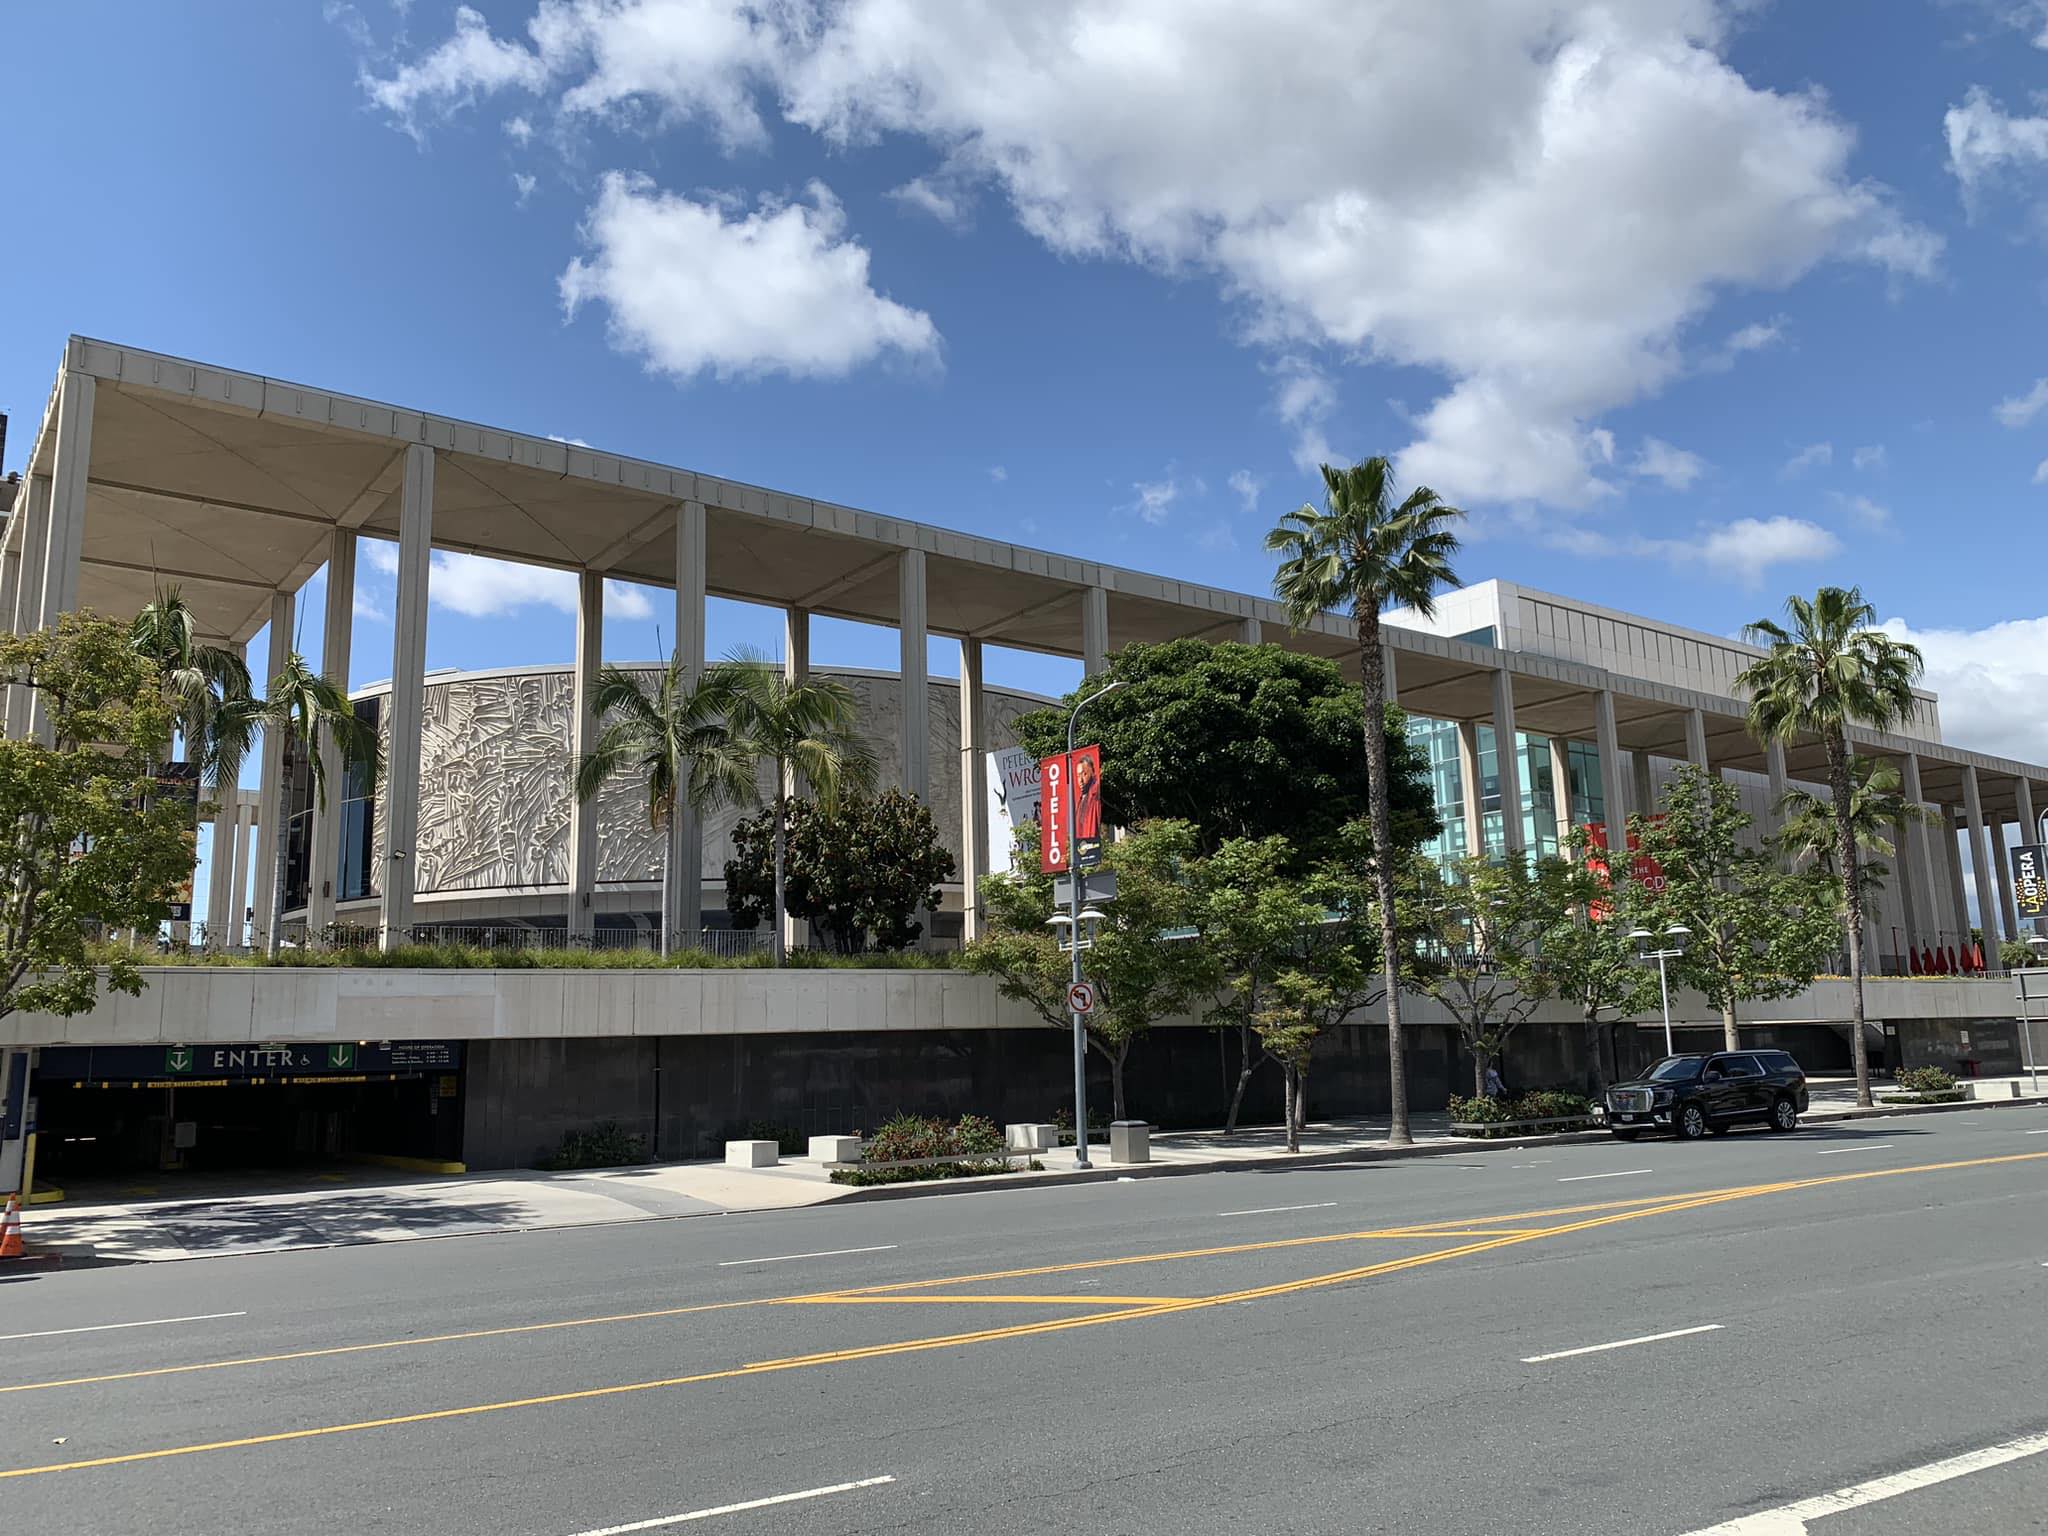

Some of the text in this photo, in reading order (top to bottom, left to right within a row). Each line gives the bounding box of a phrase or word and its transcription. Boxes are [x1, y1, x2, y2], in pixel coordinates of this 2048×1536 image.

[1003, 752, 1031, 770] PETER
[1009, 767, 1041, 788] WRO
[1049, 763, 1060, 865] OTELLO
[213, 1050, 294, 1068] ENTER
